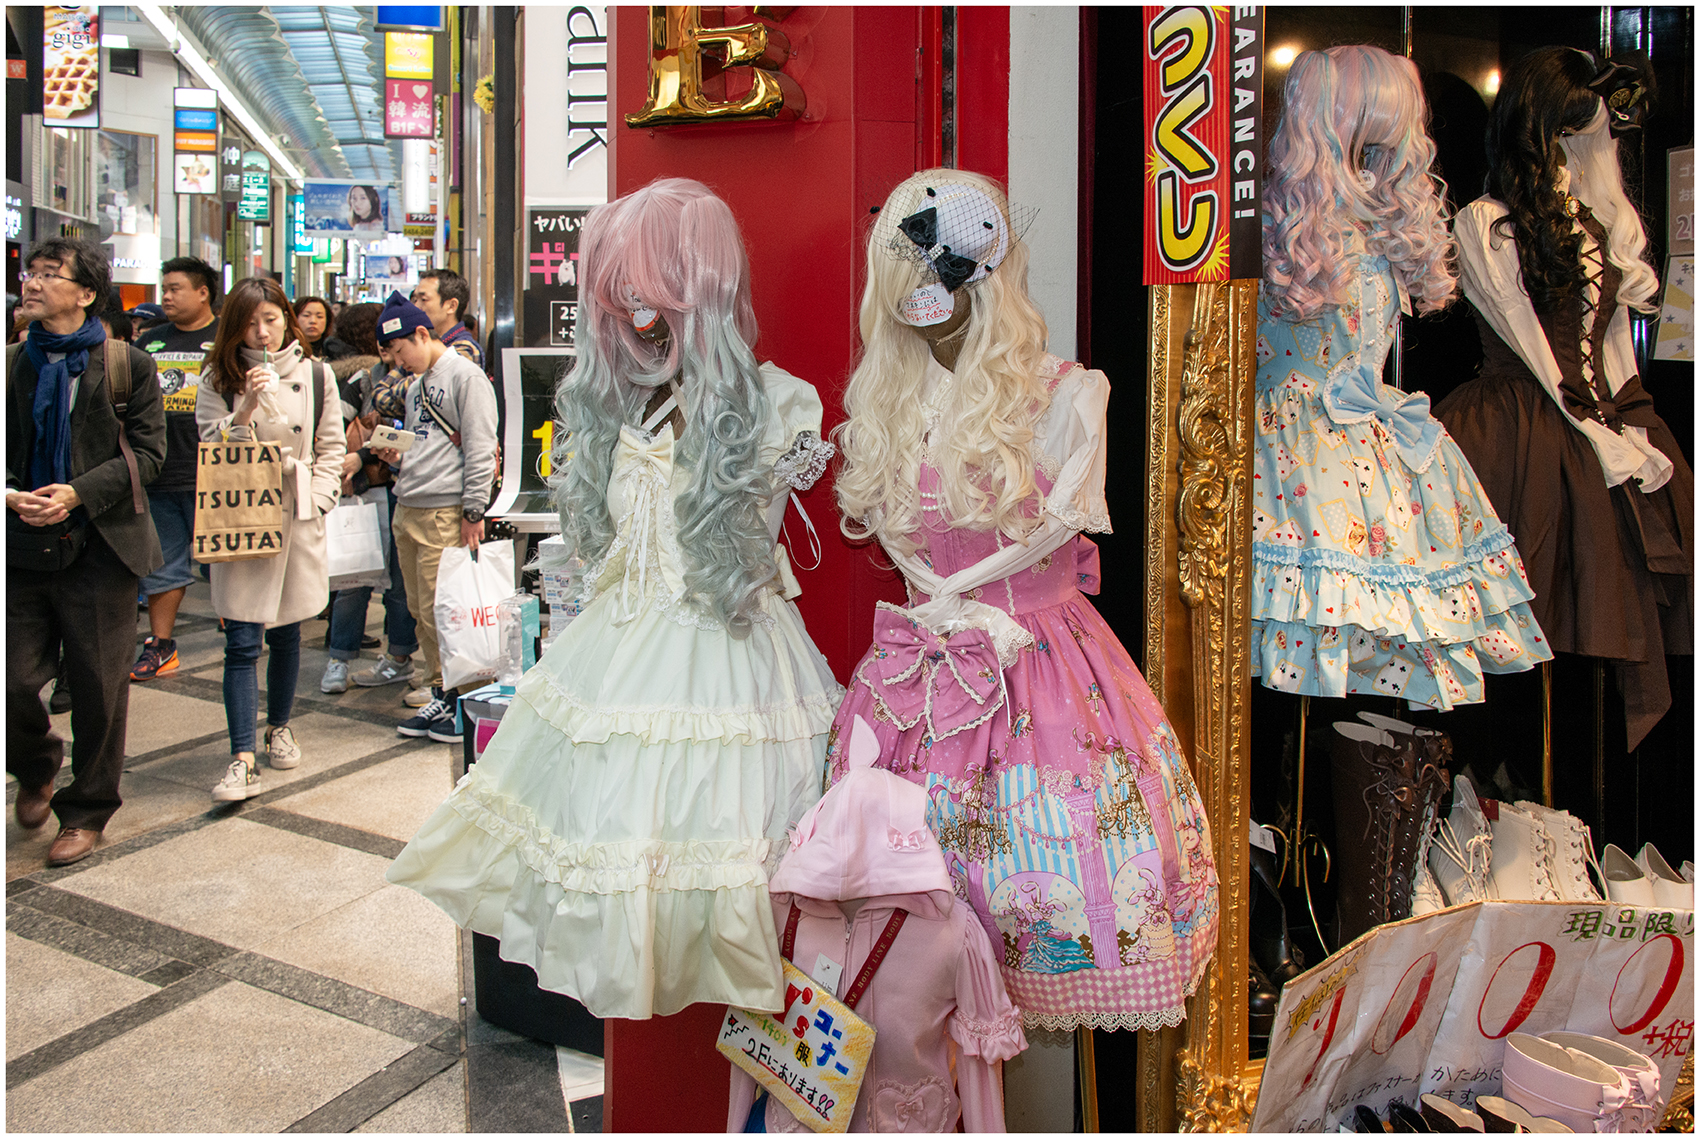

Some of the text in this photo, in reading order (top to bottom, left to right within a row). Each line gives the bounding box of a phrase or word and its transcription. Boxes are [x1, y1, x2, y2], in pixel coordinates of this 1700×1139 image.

[53, 27, 90, 49] gigi
[388, 101, 431, 118] 韓流
[391, 121, 416, 134] B1F
[857, 964, 874, 989] BODY
[871, 942, 887, 964] LINE
